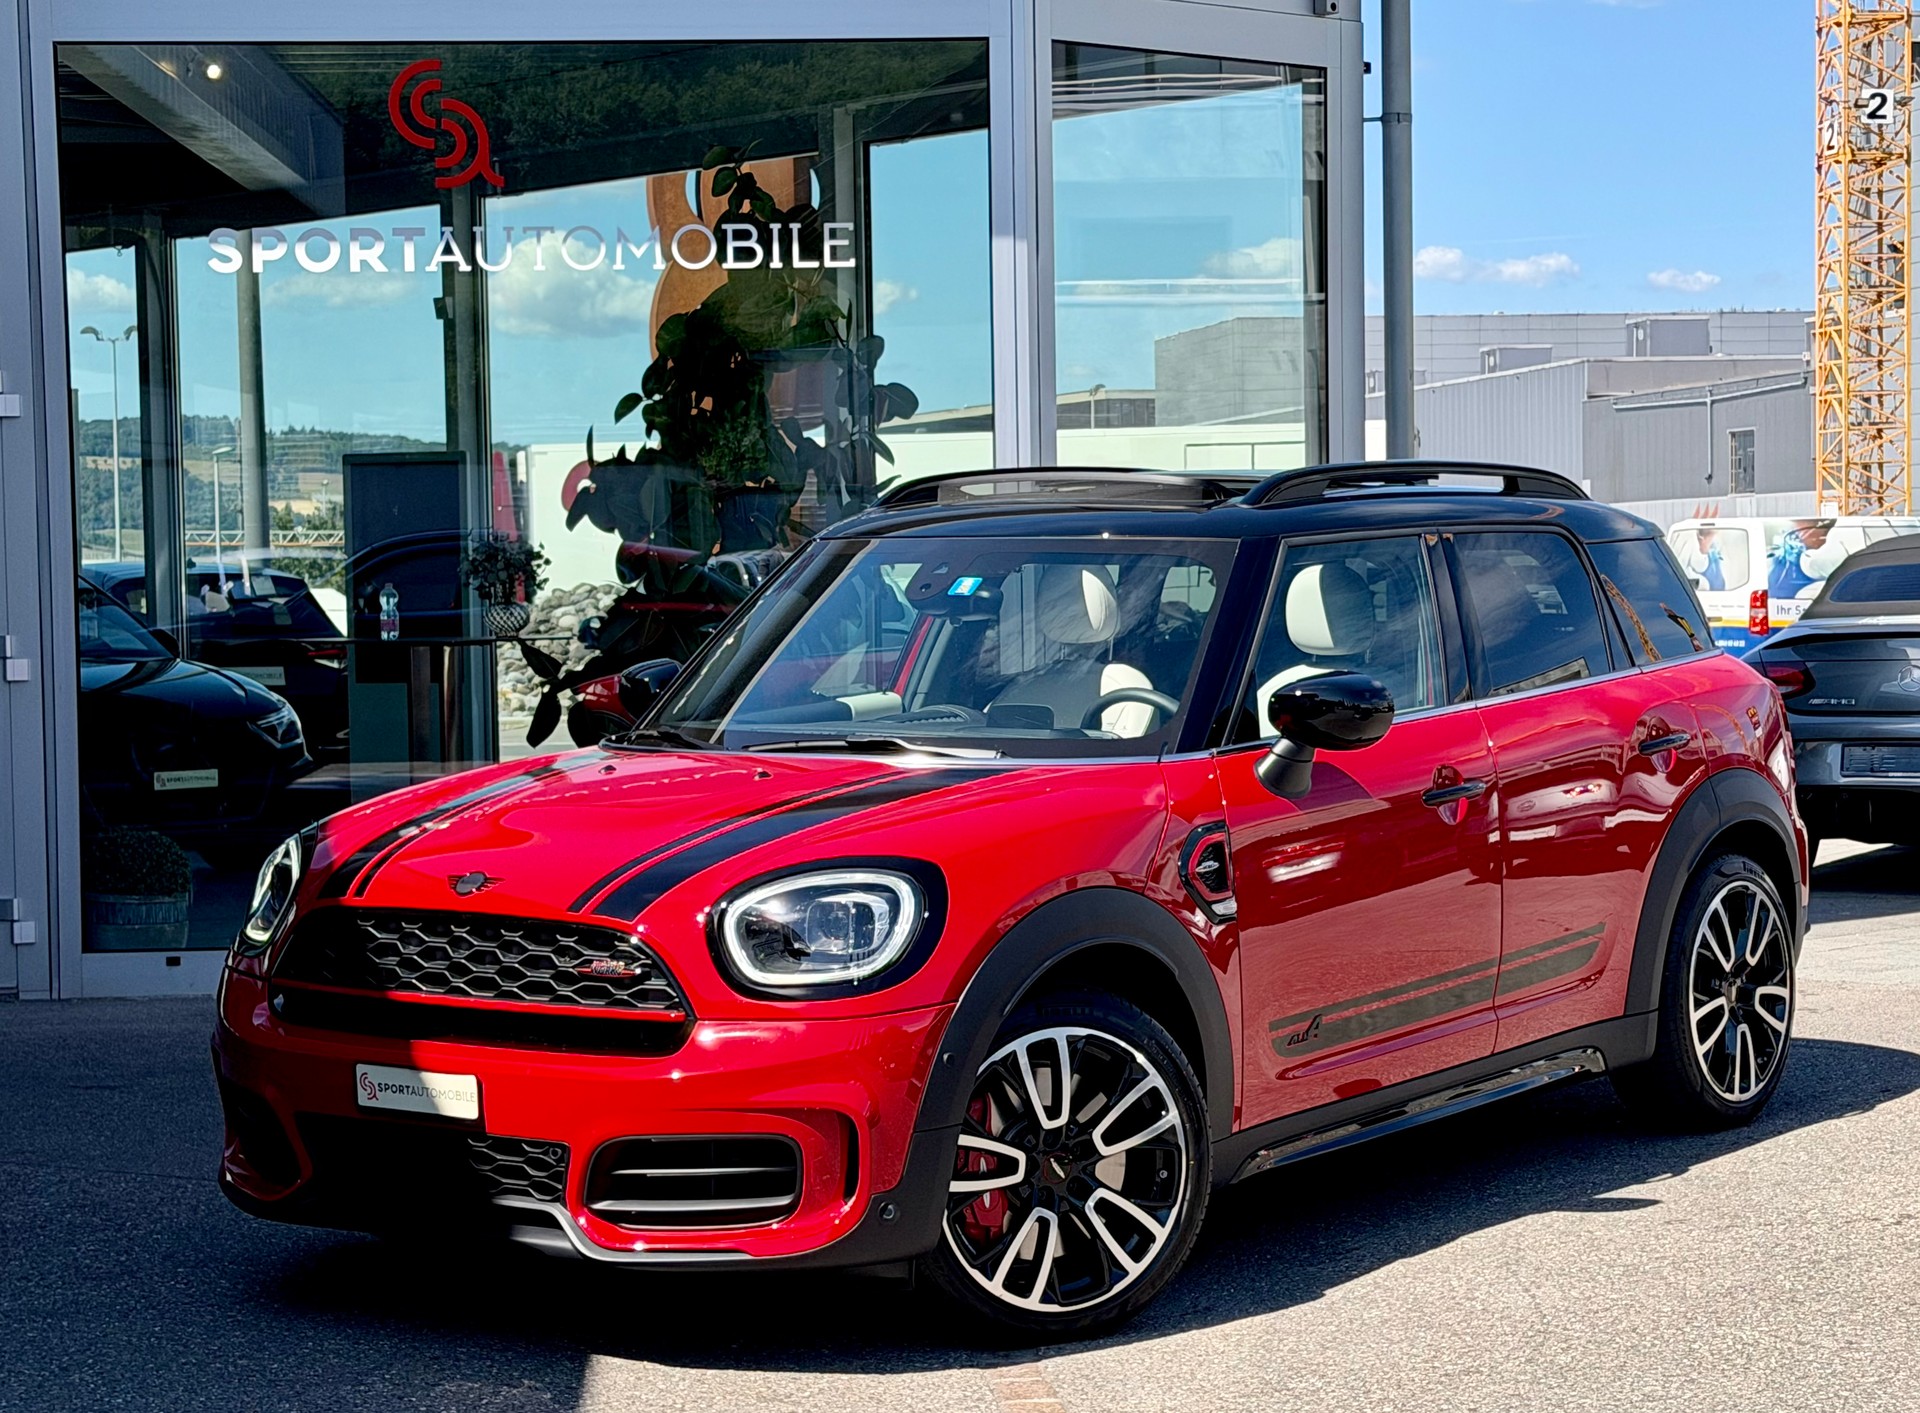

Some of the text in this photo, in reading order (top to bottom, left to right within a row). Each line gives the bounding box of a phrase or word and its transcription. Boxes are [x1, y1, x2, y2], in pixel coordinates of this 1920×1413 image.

[1867, 92, 1888, 120] 2
[1826, 122, 1835, 151] 2
[207, 221, 857, 274] SPORTAUTOMOBILE
[1776, 605, 1792, 615] Ihr
[377, 1082, 477, 1103] SPORTAUTOMOBILE
